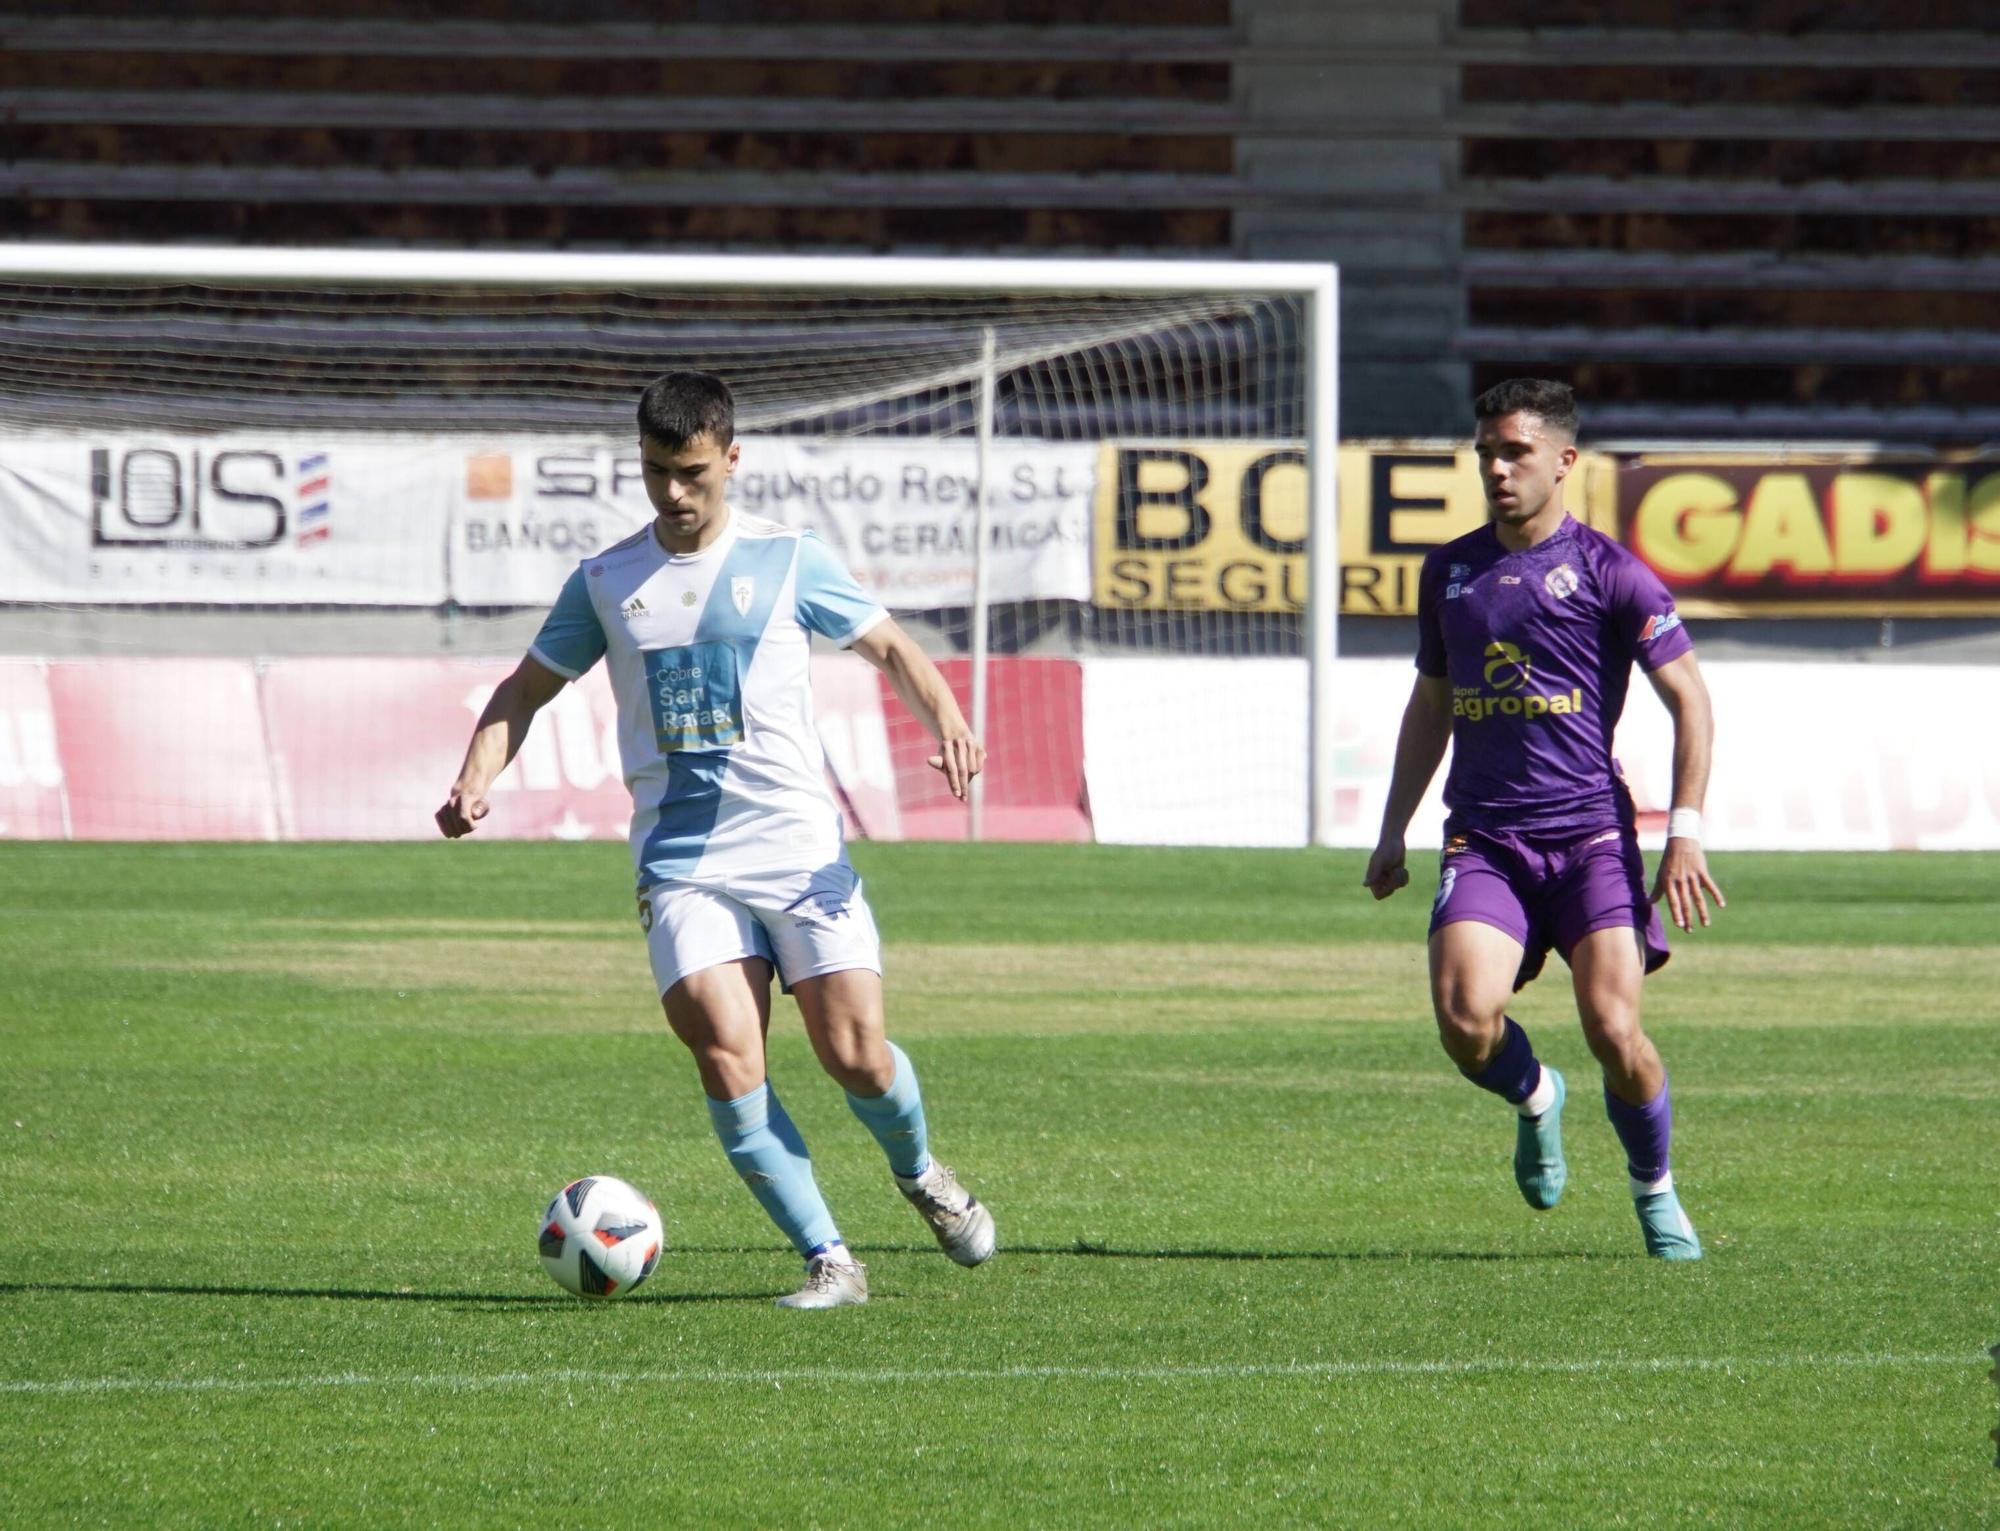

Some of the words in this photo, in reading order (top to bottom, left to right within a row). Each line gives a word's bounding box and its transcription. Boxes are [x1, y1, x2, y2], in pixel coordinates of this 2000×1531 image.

[91, 449, 287, 549] LOIS
[725, 465, 882, 513] egundo
[1110, 560, 1425, 611] SEGURI
[656, 666, 702, 683] Cobre
[660, 686, 705, 707] San
[1452, 688, 1582, 721] agropal
[662, 702, 733, 731] Rafael
